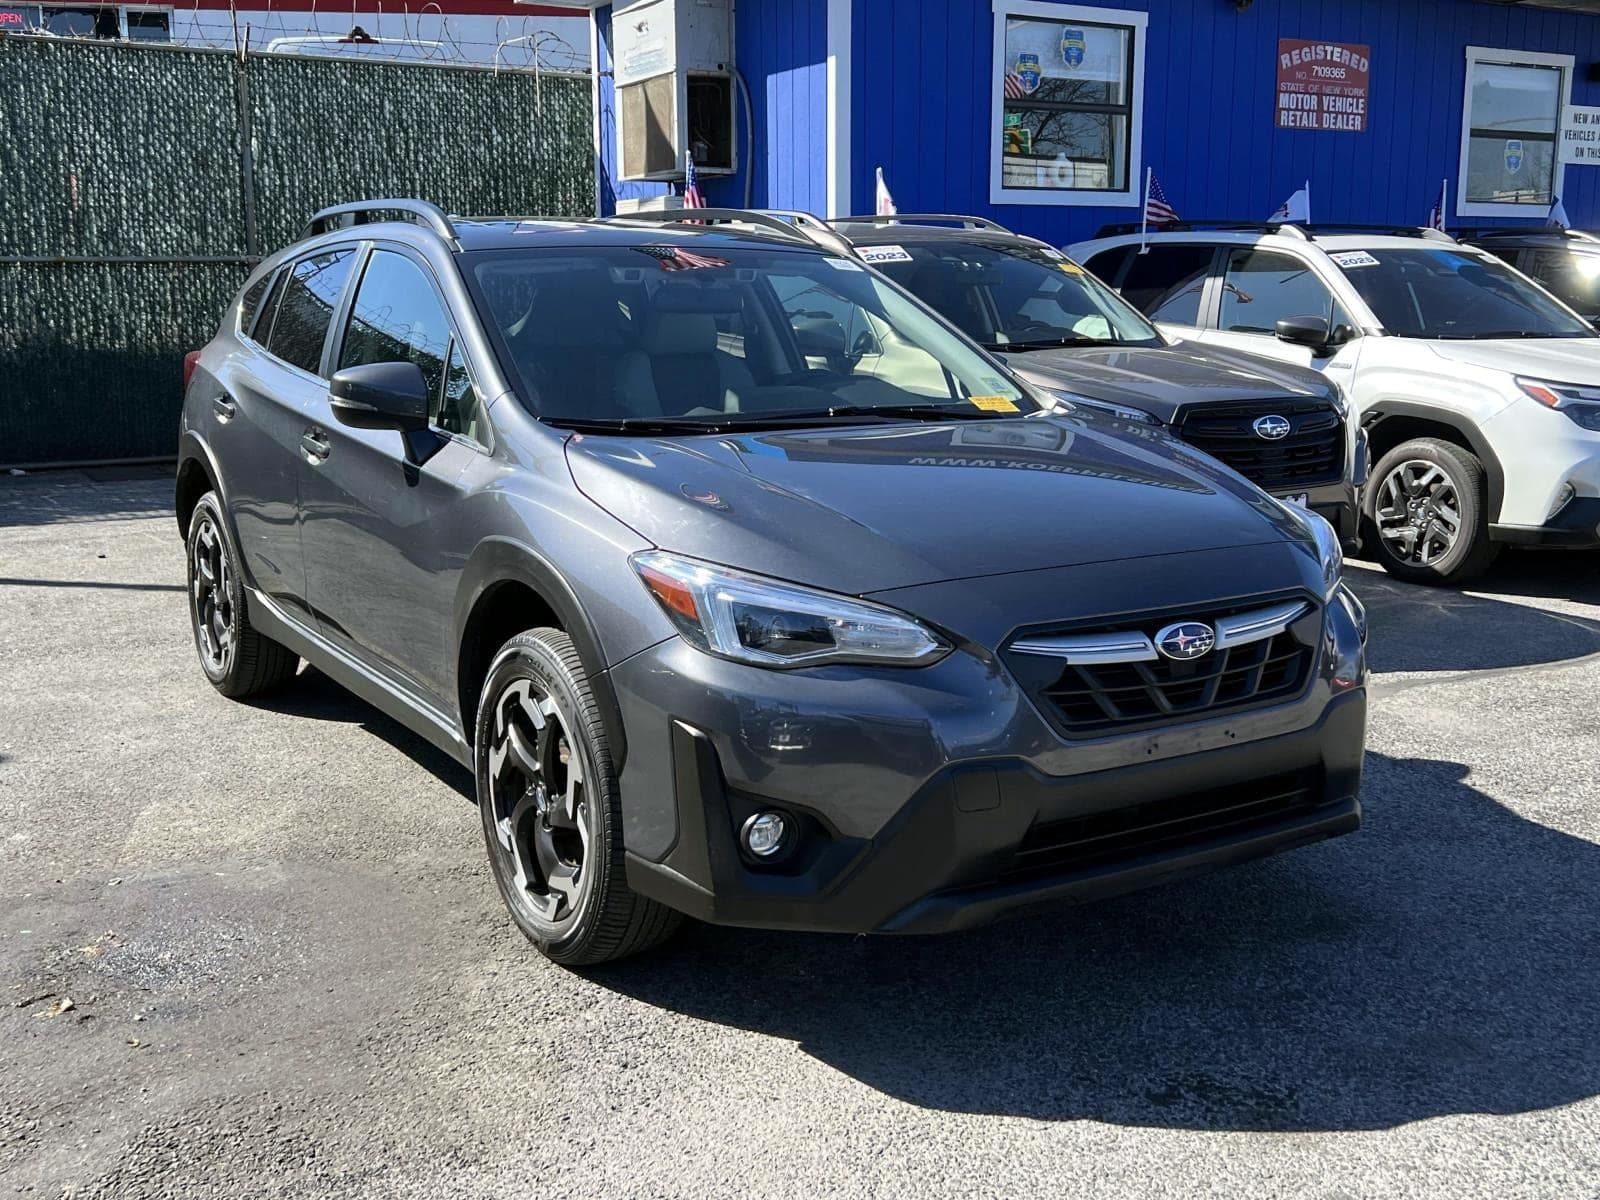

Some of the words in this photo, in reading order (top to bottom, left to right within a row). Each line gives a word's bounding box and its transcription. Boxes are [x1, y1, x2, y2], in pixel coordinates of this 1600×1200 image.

[1280, 45, 1368, 72] REGISTERED
[1312, 65, 1345, 79] 7109365
[1280, 82, 1304, 92] STATE
[1308, 84, 1319, 93] OF
[1322, 85, 1341, 95] NEW
[1344, 87, 1365, 97] YORK
[1279, 93, 1317, 110] MOTOR
[1322, 95, 1365, 113] VEHICLE
[1280, 111, 1318, 127] RETAIL
[1322, 113, 1361, 130] DEALER
[1573, 113, 1588, 124] NEW
[1565, 130, 1595, 141] VEHICLES
[1575, 147, 1584, 158] ON
[864, 252, 908, 261] 2023
